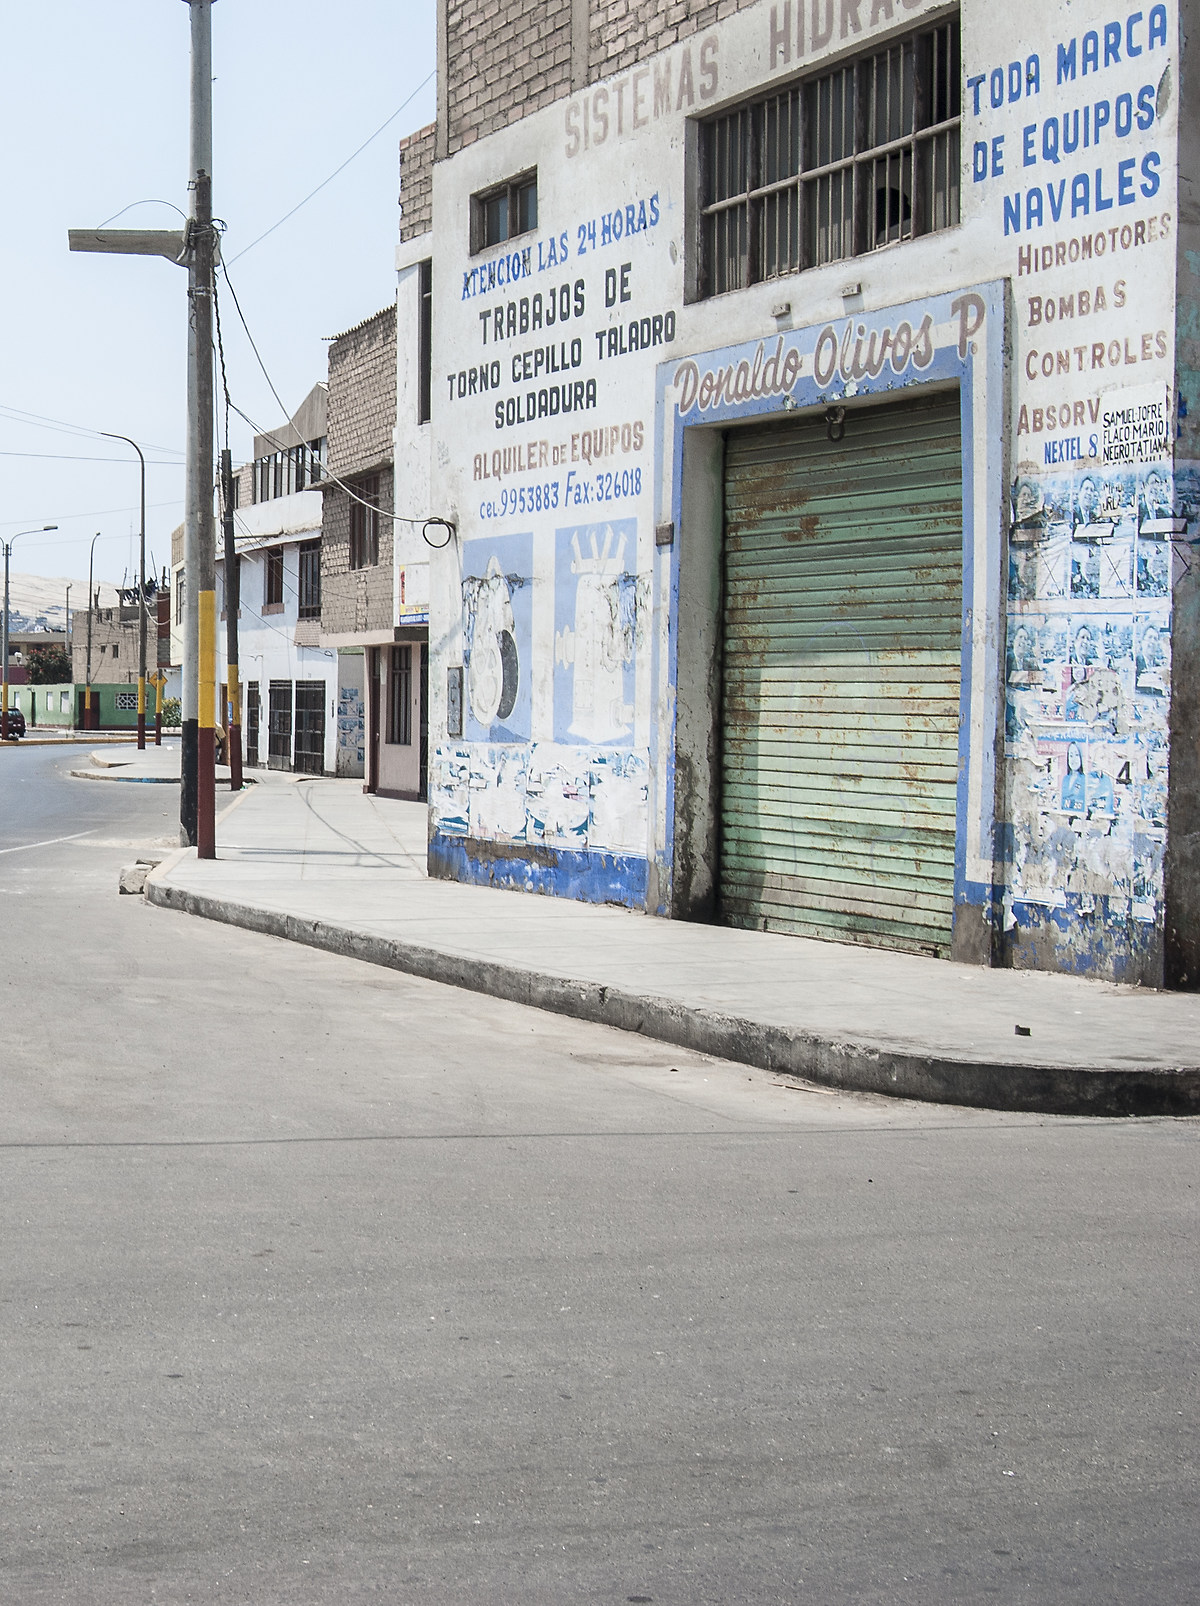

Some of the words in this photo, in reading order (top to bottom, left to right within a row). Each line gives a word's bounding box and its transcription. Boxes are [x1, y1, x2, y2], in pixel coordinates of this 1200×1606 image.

[770, 0, 925, 71] HIDR
[967, 54, 1040, 116] TODA
[1057, 3, 1167, 86] MARCA
[565, 35, 720, 159] SISTEMAS
[973, 135, 1005, 183] DE
[1023, 84, 1155, 168] EQUIPOS
[1003, 151, 1161, 237] NAVALES
[461, 246, 532, 301] ATENCION
[537, 230, 569, 272] LAS
[577, 220, 597, 256] 24
[600, 191, 660, 247] HORAS
[1017, 212, 1172, 277] HIDROMOTORES
[479, 278, 586, 345] TRABAJOS
[605, 262, 632, 308] DE
[1028, 280, 1127, 327] BOMBAS
[447, 360, 501, 401] TORNO
[511, 338, 582, 384] CEPILLO
[595, 310, 676, 360] TALADRO
[673, 335, 803, 414] Donaldo
[813, 314, 933, 387] Olivos
[1026, 330, 1167, 381] CONTROLES
[494, 378, 597, 429] SOLDADURA
[473, 439, 550, 481] ALQUILER
[552, 443, 568, 466] DE
[571, 421, 644, 466] EQUIPOS
[596, 467, 642, 502] 326018
[1044, 436, 1085, 465] NEXTEL
